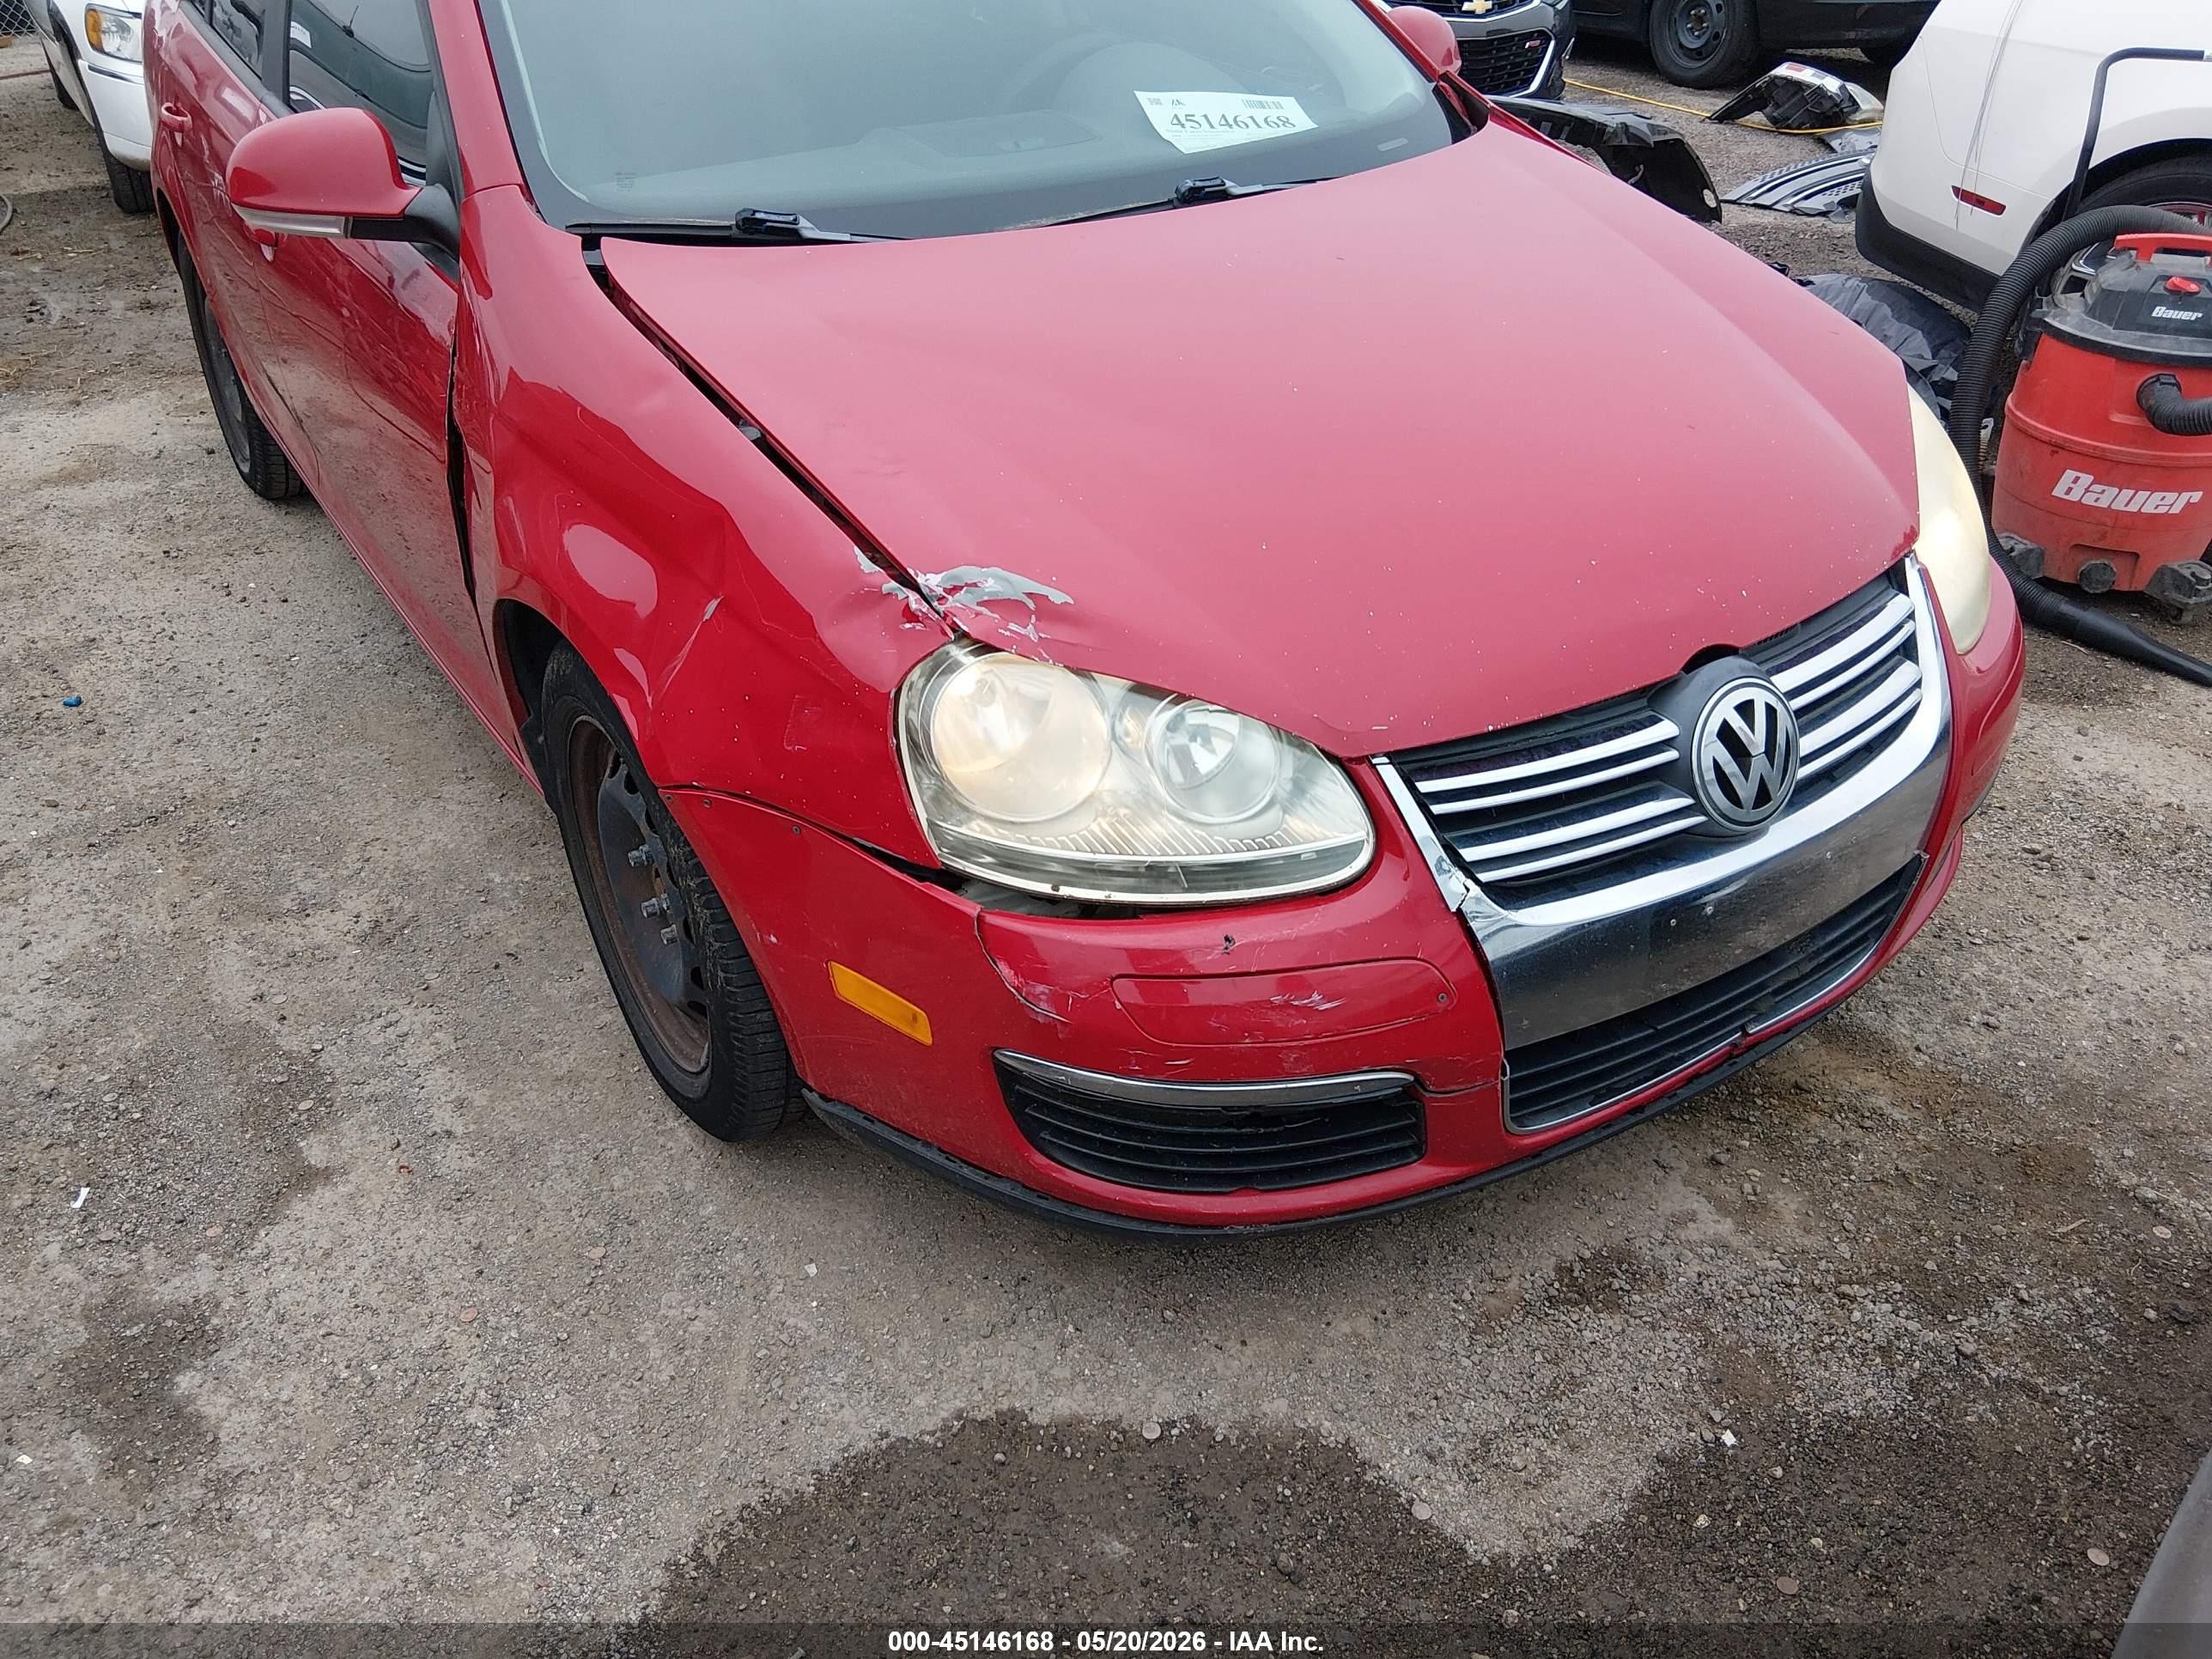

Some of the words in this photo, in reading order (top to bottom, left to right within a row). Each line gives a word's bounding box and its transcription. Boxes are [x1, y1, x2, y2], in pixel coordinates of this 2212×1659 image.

[1170, 112, 1297, 130] 45146168
[2151, 306, 2203, 321] Bauer
[2051, 469, 2204, 514] Bauer
[1702, 690, 1792, 820] VW
